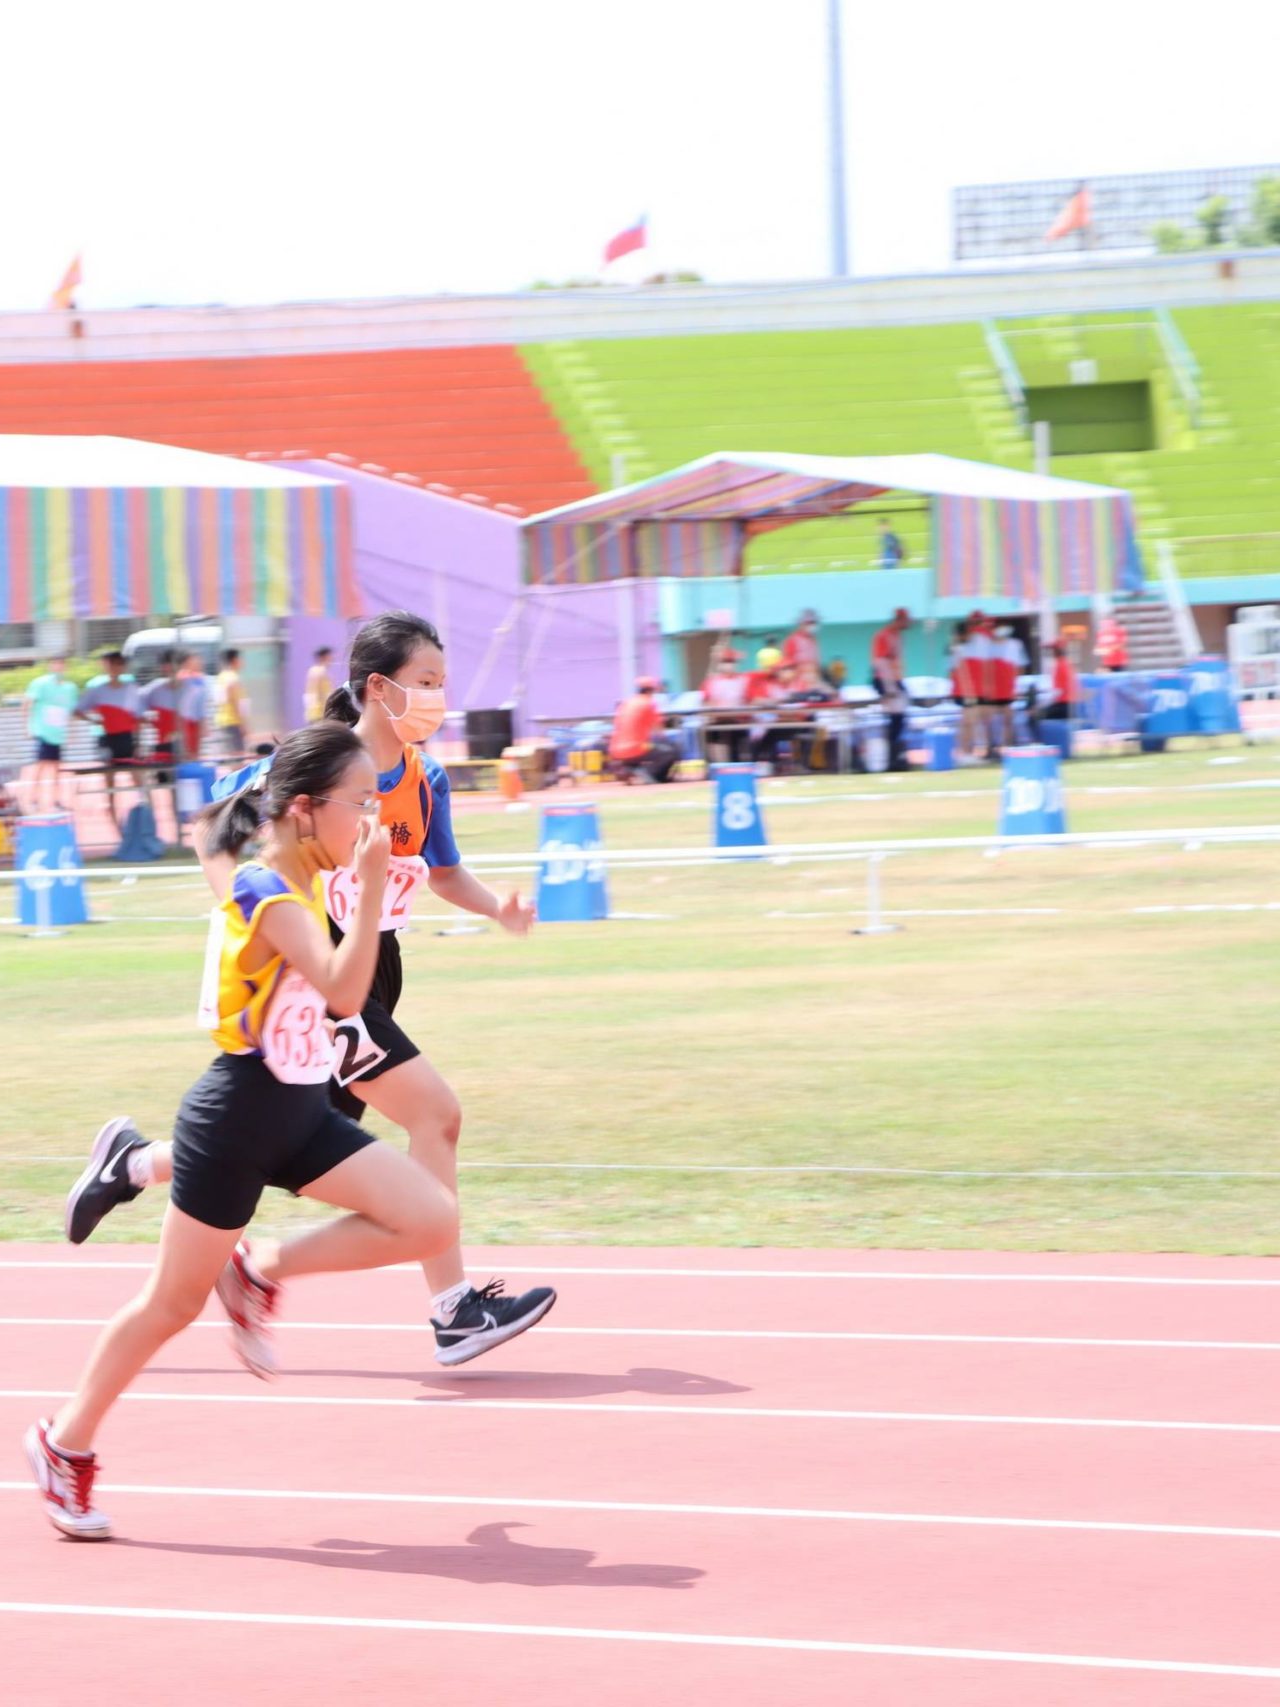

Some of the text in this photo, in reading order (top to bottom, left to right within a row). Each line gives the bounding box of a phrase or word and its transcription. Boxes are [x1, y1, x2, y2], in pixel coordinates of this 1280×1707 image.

[721, 791, 756, 830] 8
[25, 849, 56, 891] 6
[328, 868, 415, 921] 62
[333, 1025, 379, 1083] 2
